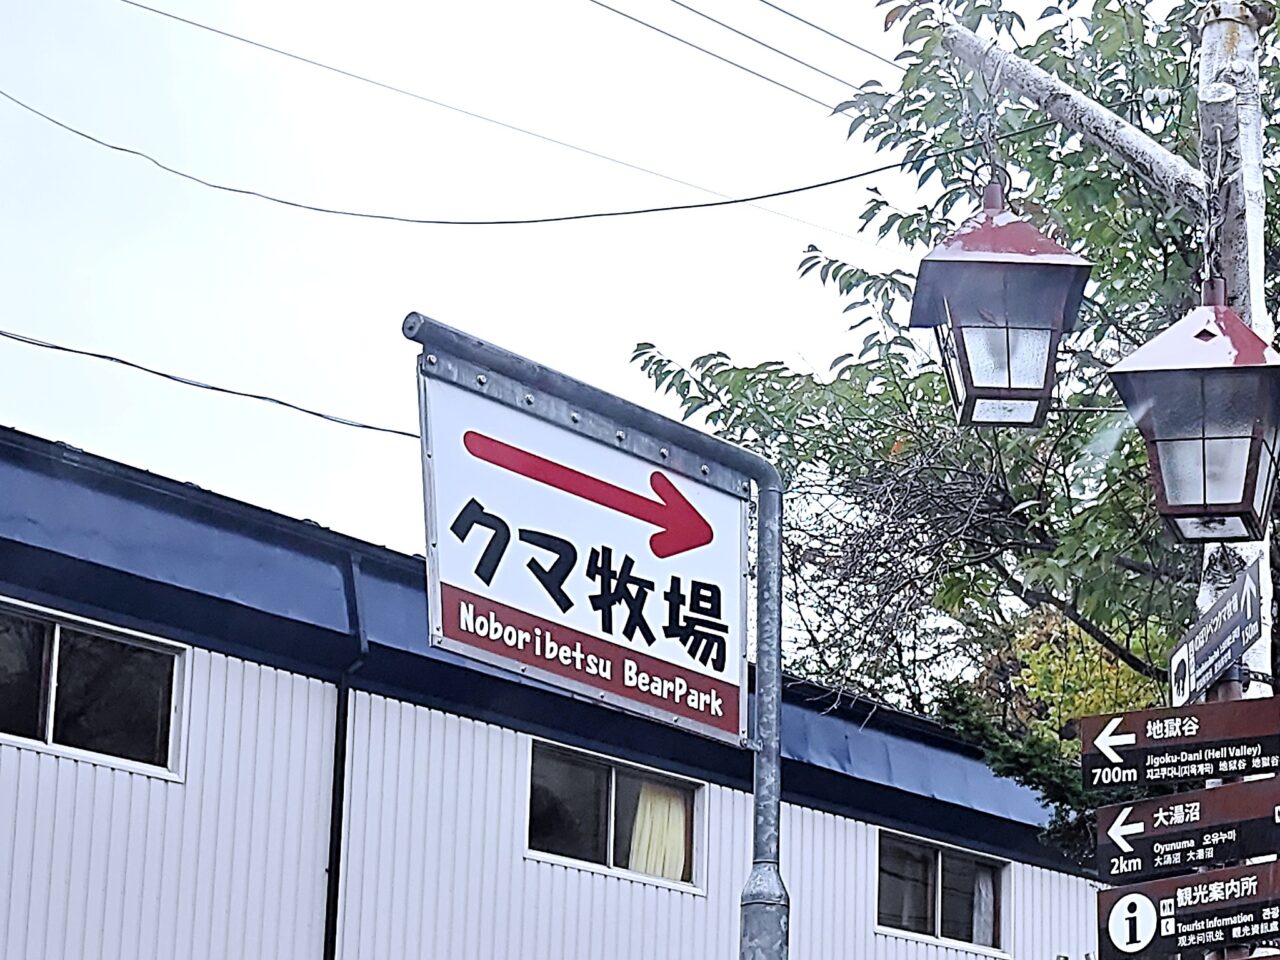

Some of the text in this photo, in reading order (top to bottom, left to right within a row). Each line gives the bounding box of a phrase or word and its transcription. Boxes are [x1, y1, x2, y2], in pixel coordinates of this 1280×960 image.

[450, 498, 729, 672] クマ牧場
[1241, 621, 1259, 646] 150m
[458, 601, 724, 718] Noboribetsu BearPark
[1146, 716, 1200, 740] 地獄谷
[1145, 744, 1262, 767] Jigoku-Dani (Hell Valley)
[1091, 766, 1138, 785] 700m
[1153, 802, 1200, 828] 大湯沼
[1153, 839, 1195, 854] Oyunuma
[1202, 829, 1236, 845] 오유누마
[1110, 856, 1142, 875] 2km
[1177, 876, 1258, 908] 観光案内所
[1177, 913, 1254, 933] Tourist Information
